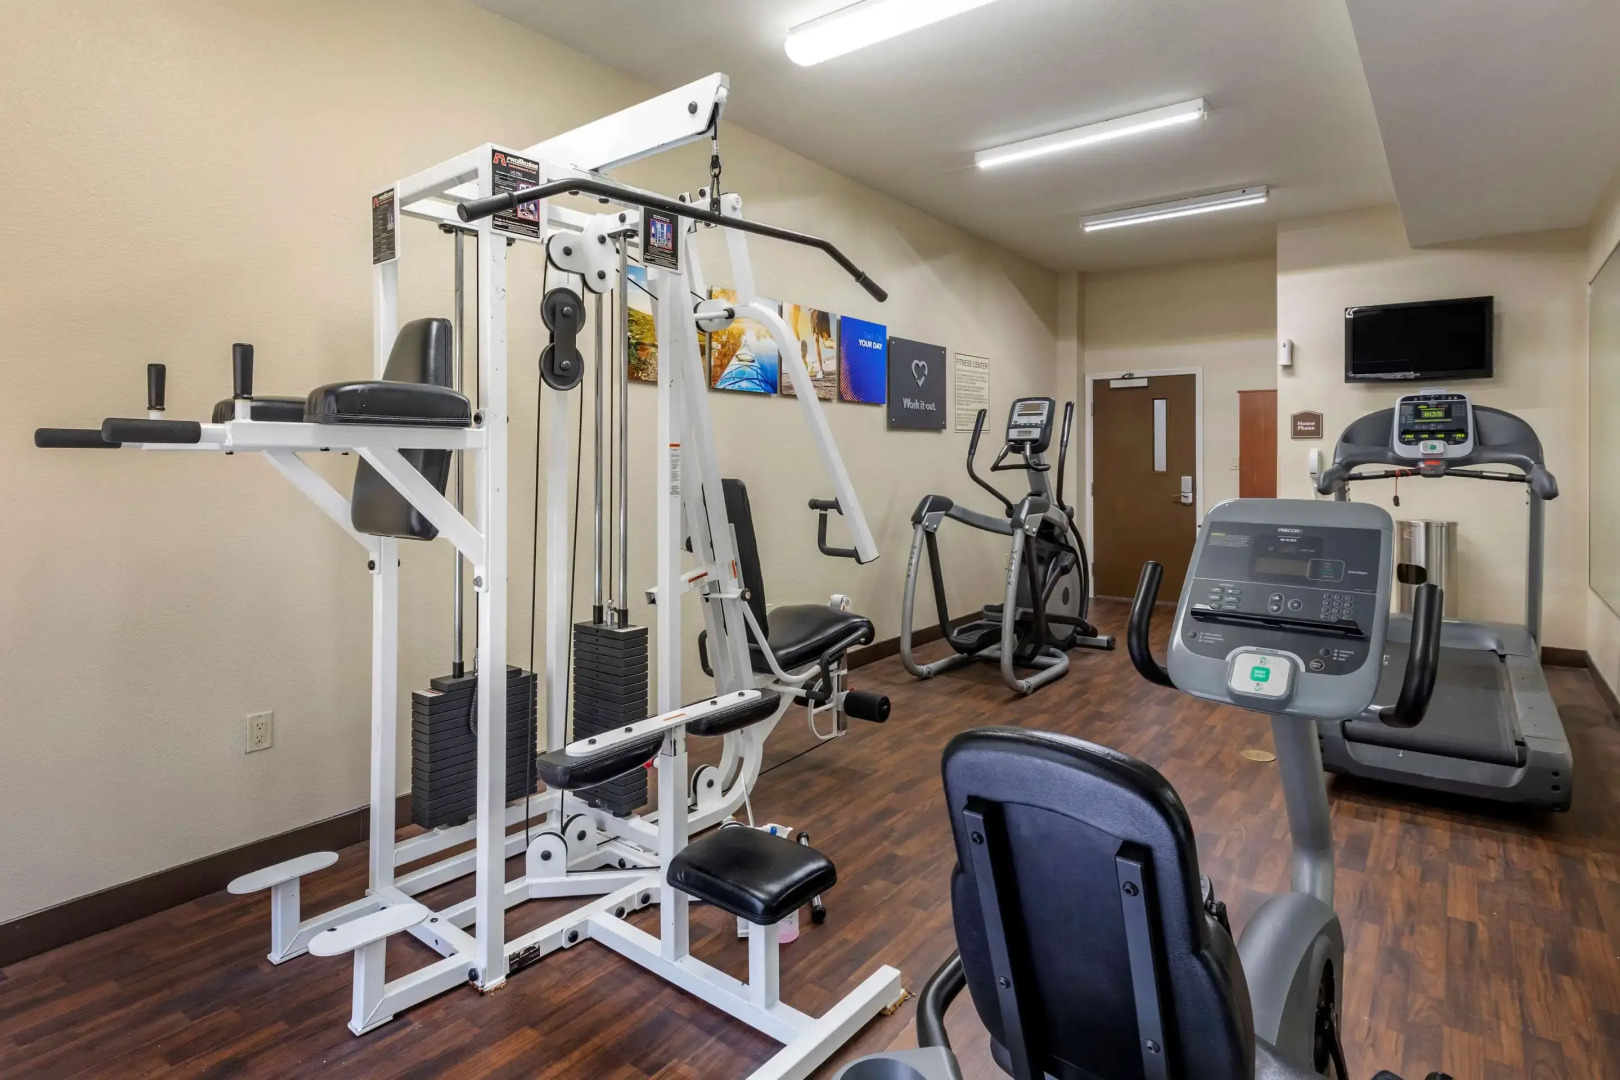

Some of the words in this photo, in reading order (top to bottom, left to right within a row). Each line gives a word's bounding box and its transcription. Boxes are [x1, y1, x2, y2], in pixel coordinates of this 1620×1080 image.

[858, 338, 872, 348] YOUR
[873, 341, 883, 350] DAY
[956, 358, 972, 368] FITNESS
[973, 361, 988, 370] CENTER
[902, 398, 920, 410] Work
[920, 400, 925, 410] it
